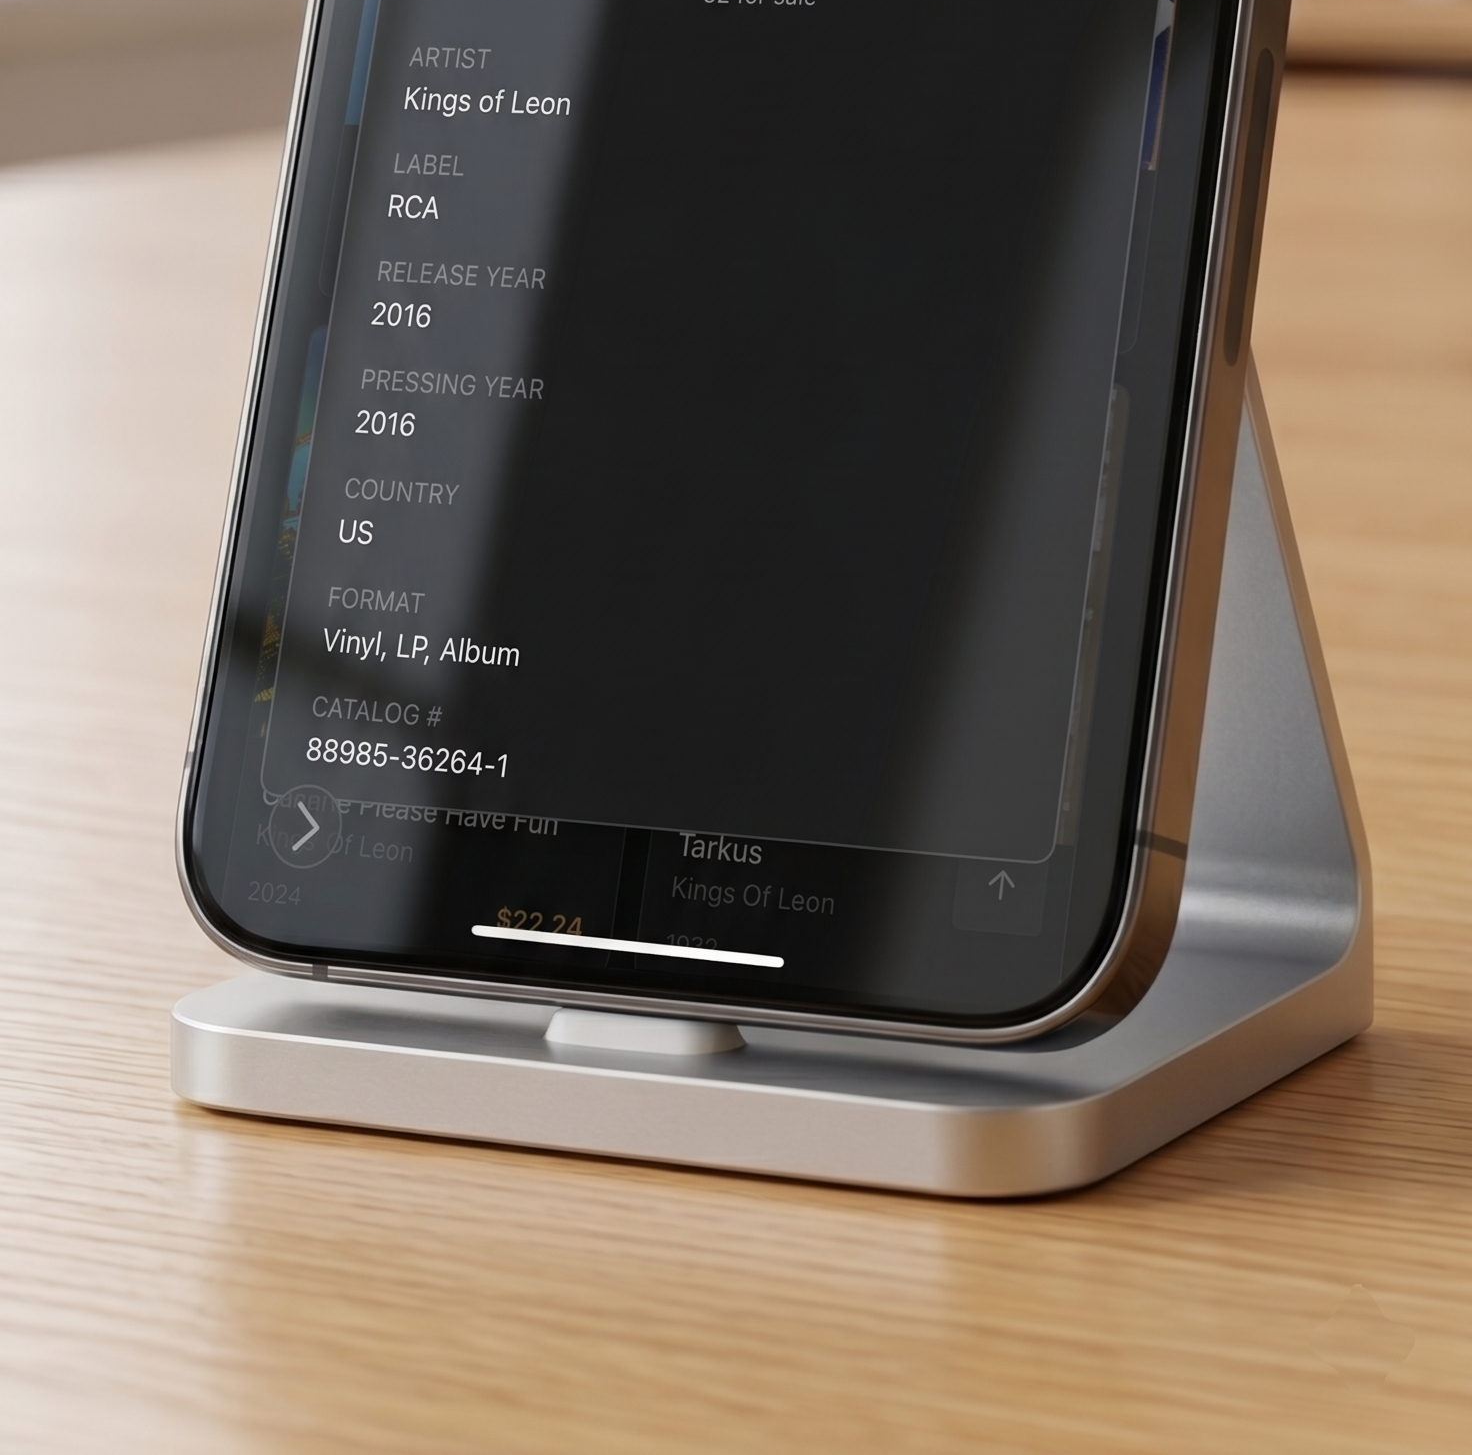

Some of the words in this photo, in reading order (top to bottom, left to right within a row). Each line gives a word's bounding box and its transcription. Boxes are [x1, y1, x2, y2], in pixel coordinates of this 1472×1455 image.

[409, 46, 491, 69] ARTIST
[404, 86, 471, 117] Kings
[479, 88, 505, 113] of
[511, 90, 571, 116] Leon
[394, 152, 464, 177] LABEL
[388, 194, 439, 219] RCA
[377, 260, 479, 286] RELEASE
[487, 265, 546, 290] YEAR
[371, 301, 432, 328] 2016
[361, 368, 477, 396] PRESSING
[485, 375, 545, 400] YEAR
[355, 409, 416, 437] 2016
[345, 477, 460, 505] COUNTRY
[339, 519, 374, 545] US
[328, 586, 425, 614] FORMAT
[324, 627, 386, 662] Vinyl,
[396, 633, 430, 666] LP,
[439, 637, 520, 667] Album
[312, 695, 420, 726] CATALOG
[426, 705, 443, 728] #
[306, 736, 508, 778] 88985-36264-1
[359, 834, 413, 863] Leon
[679, 831, 763, 864] Tarkus
[247, 880, 302, 906] 2024
[672, 875, 735, 908] Kings
[743, 883, 772, 907] Of
[778, 887, 835, 915] Leon
